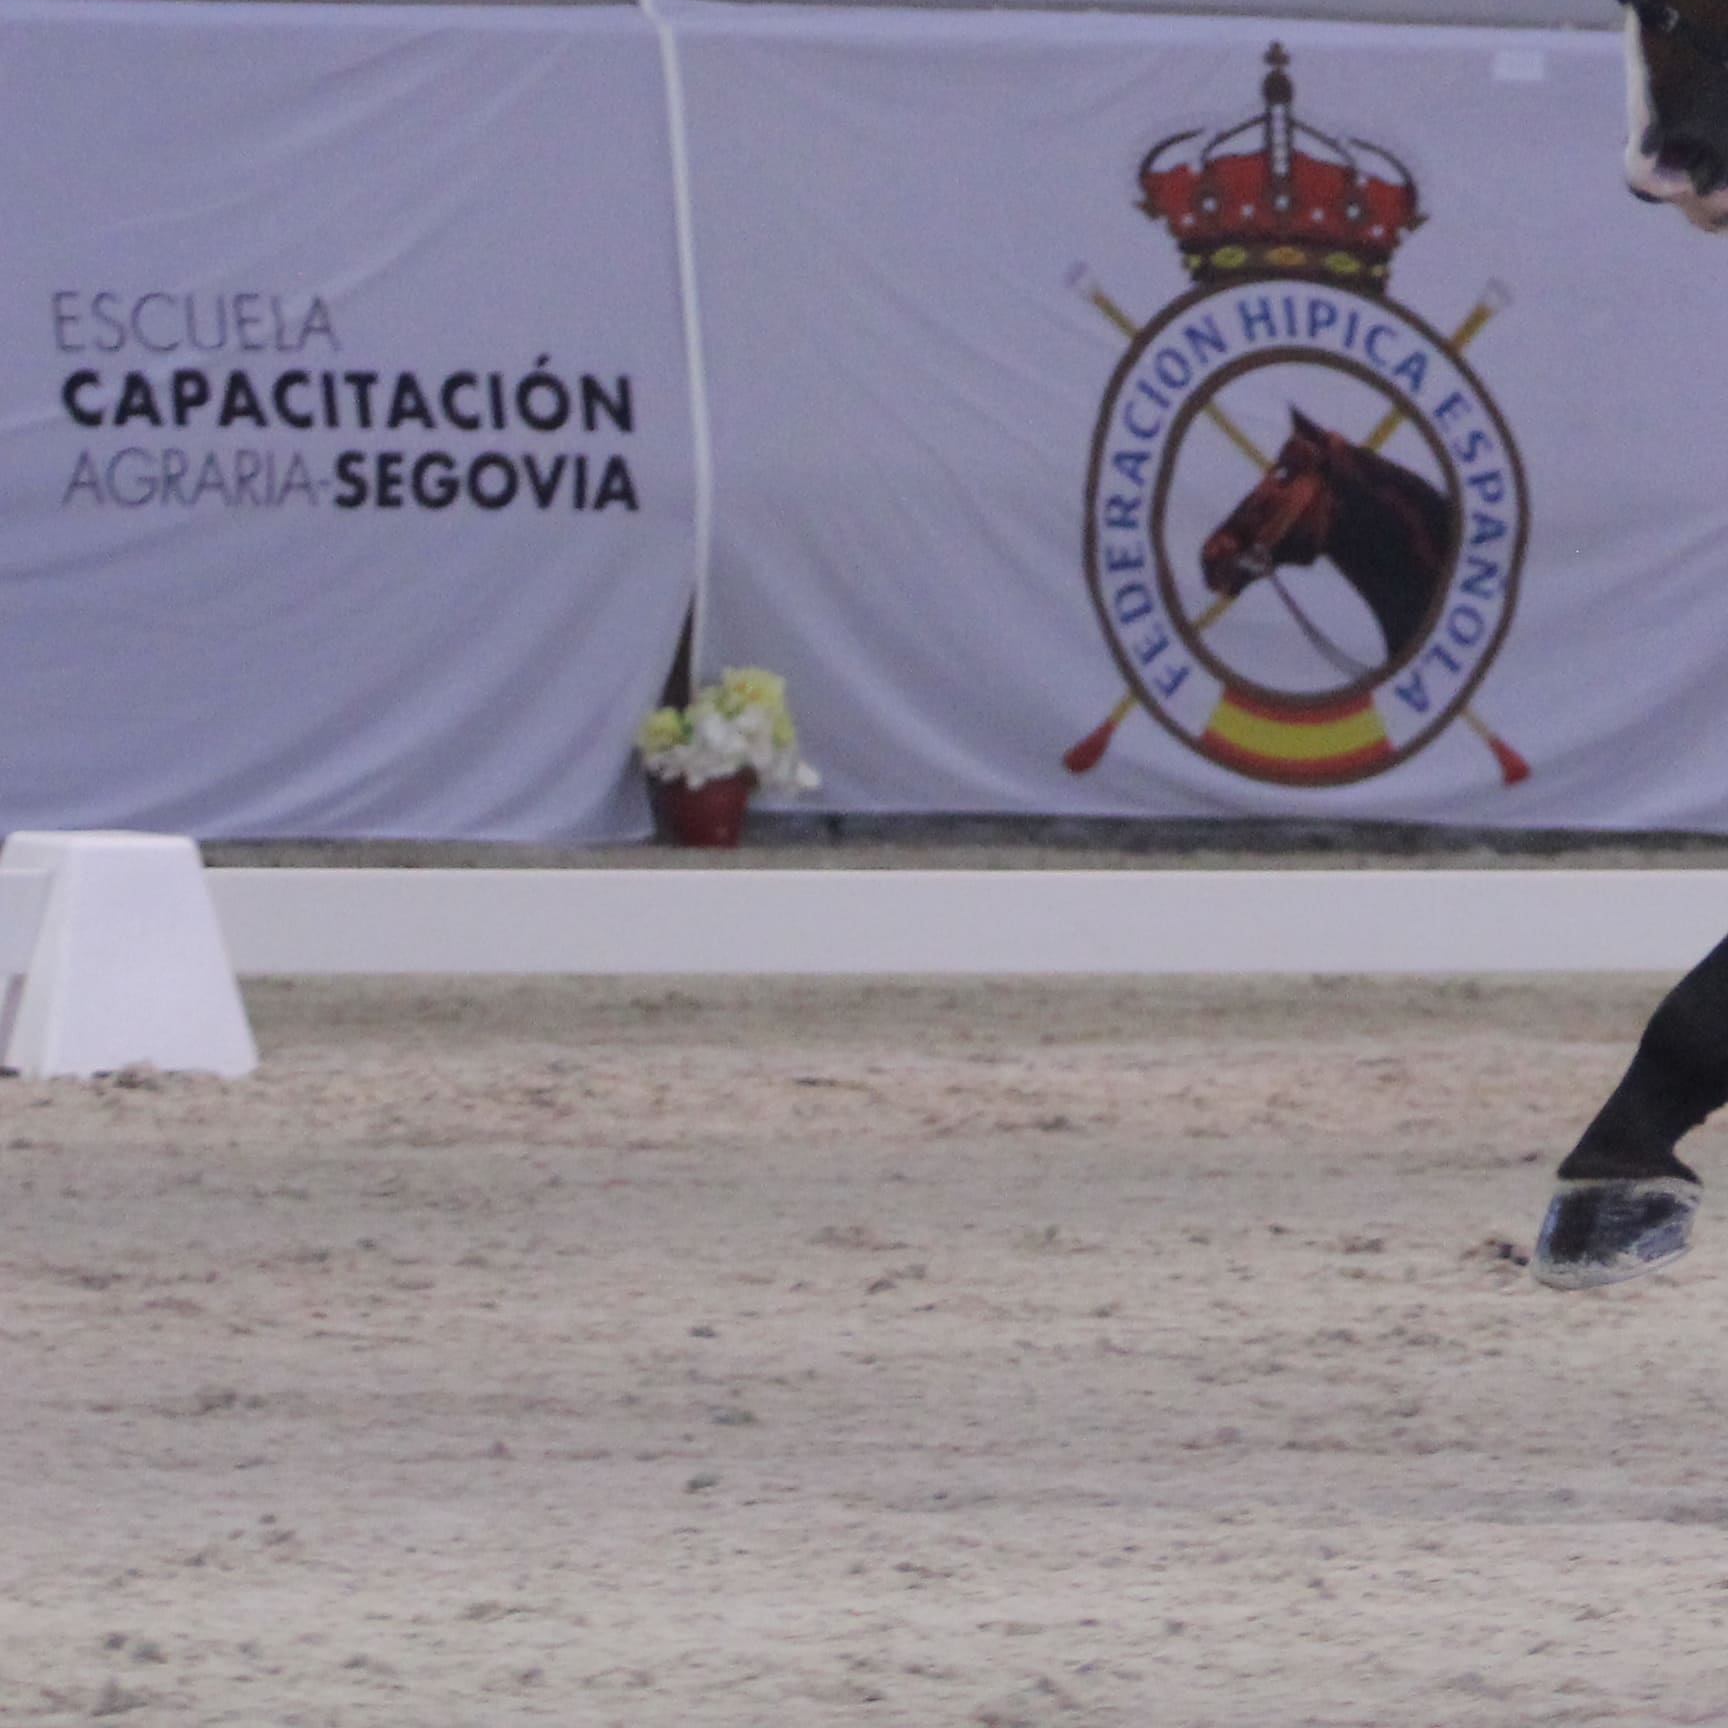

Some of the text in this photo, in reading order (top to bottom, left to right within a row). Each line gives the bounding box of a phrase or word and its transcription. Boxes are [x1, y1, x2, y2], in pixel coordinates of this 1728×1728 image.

[53, 290, 339, 354] ESCUELA
[61, 353, 635, 433] CAPACITACIÓN
[1105, 314, 1229, 699] FEDERACION
[1238, 297, 1430, 392] HIPICA
